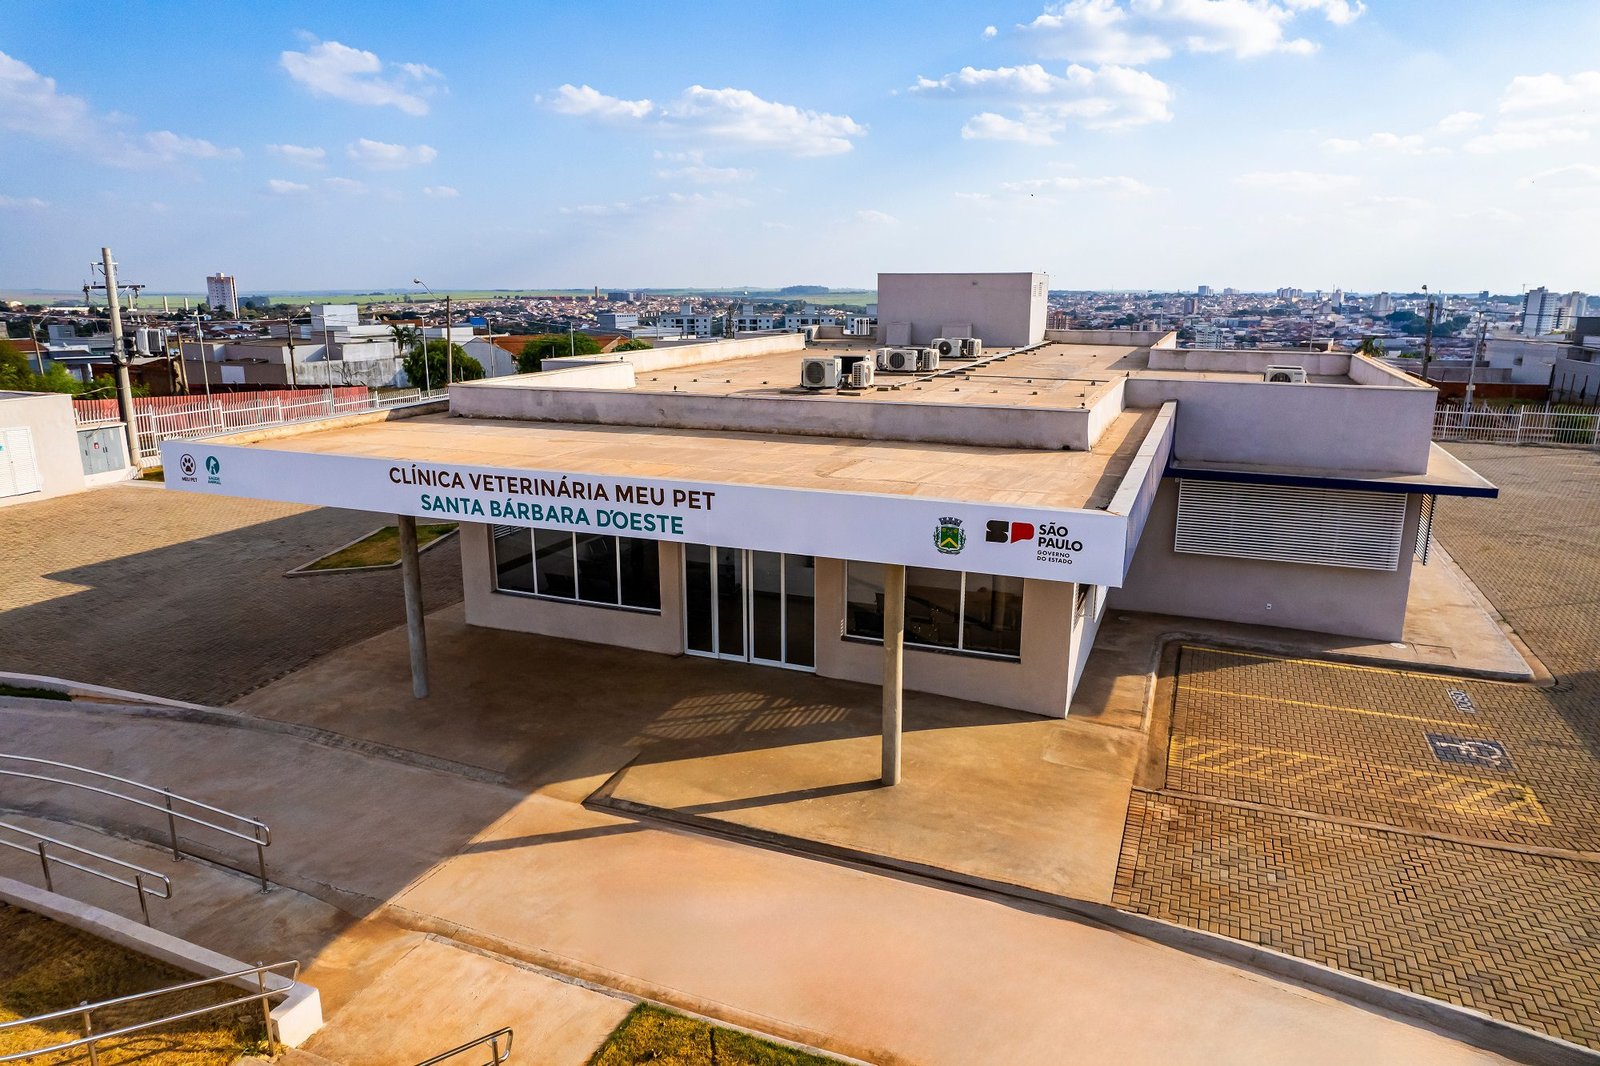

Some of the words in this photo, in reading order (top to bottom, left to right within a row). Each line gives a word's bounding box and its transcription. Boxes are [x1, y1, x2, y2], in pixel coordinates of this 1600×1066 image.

[389, 463, 465, 489] CLÍNICA
[468, 473, 610, 502] VETERINÁRIA
[615, 484, 665, 506] MEU
[673, 489, 716, 511] PET
[421, 493, 485, 516] SANTA
[489, 498, 591, 526] BÁRBARA
[596, 509, 684, 535] D'OESTE
[1038, 522, 1069, 538] SÃO
[1038, 536, 1084, 552] PAULO
[1037, 550, 1070, 558] GOVERNO
[1048, 557, 1073, 565] ESTADO
